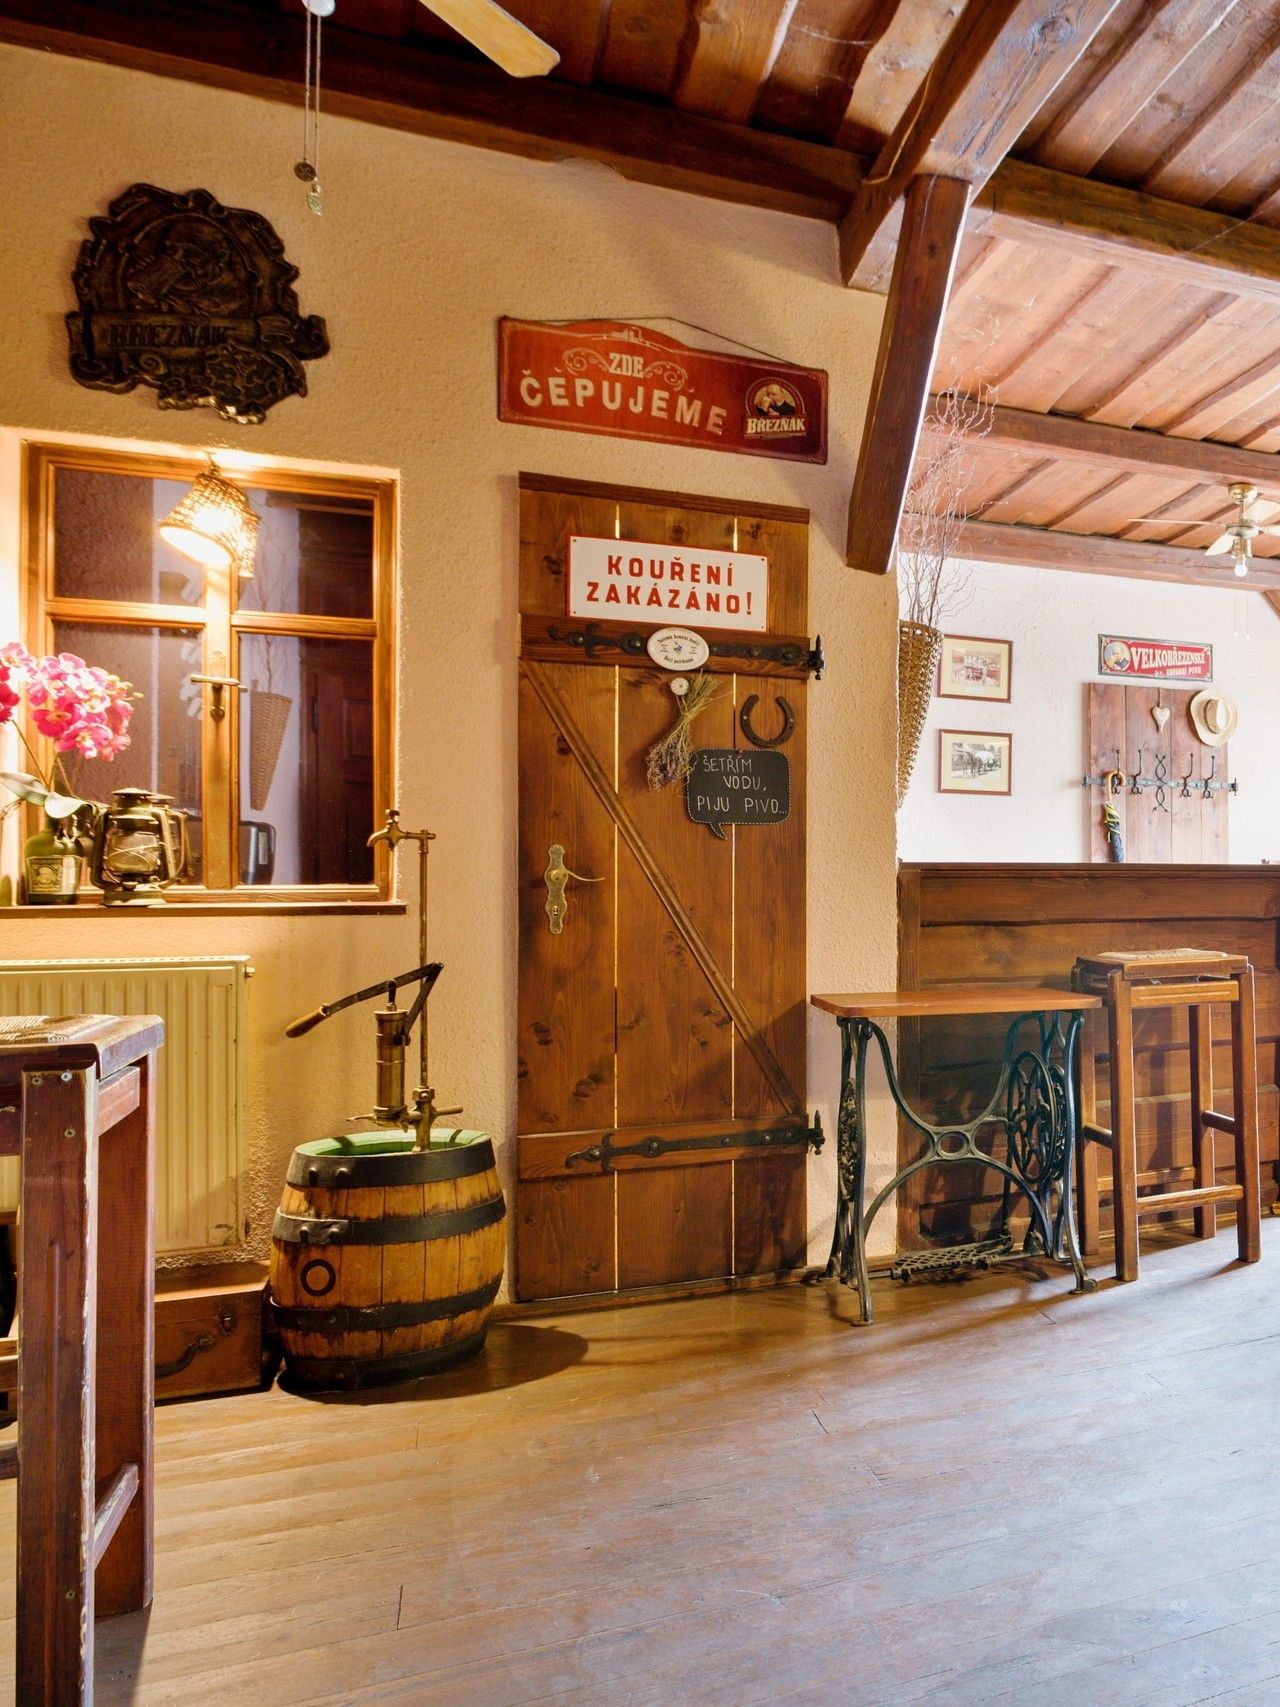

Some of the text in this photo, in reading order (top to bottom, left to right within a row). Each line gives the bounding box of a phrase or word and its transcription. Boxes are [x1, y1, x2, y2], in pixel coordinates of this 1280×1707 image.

[607, 352, 645, 379] ZDE
[519, 369, 728, 436] ČEPUJEME
[607, 556, 734, 587] KOUŘENÍ
[586, 581, 753, 616] ZAKÁZÁNO!
[702, 754, 753, 773] ŠETŘÍM
[723, 775, 767, 792] VODU,
[697, 795, 730, 812] PIJU
